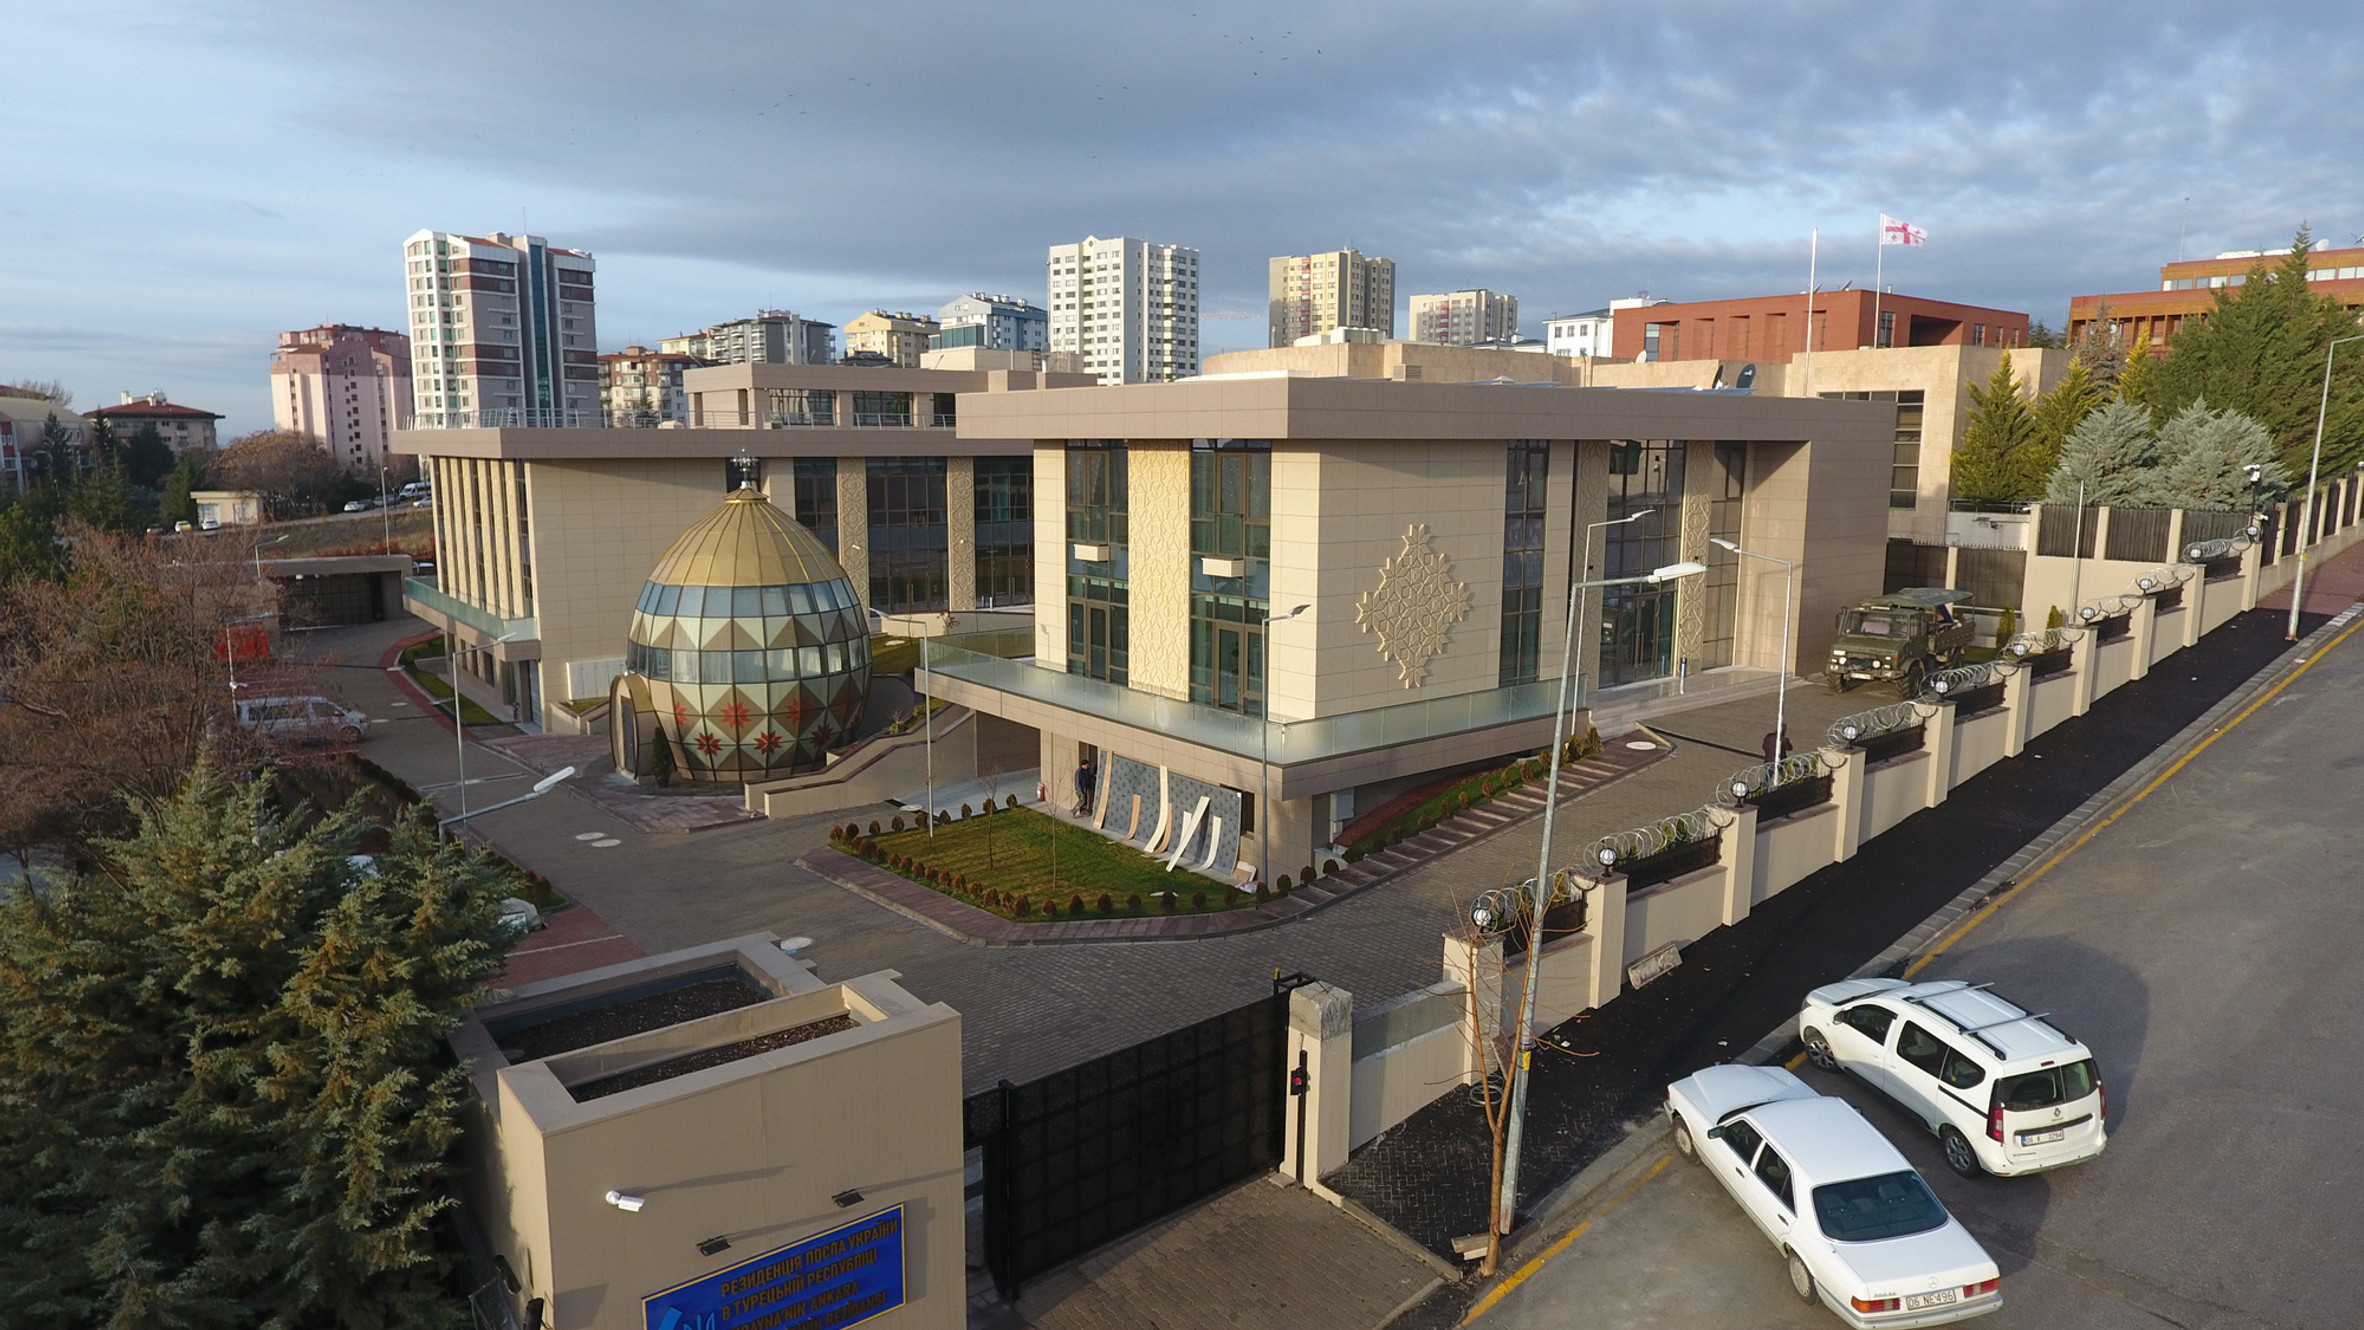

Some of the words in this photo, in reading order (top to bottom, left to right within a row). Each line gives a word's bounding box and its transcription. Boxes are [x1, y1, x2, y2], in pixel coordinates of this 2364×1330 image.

[721, 1254, 802, 1298] РЕЗИДЕНЦІЯ
[805, 1239, 846, 1266] ПОСЛА
[847, 1218, 898, 1250] УКРАЇНИ
[721, 1304, 731, 1321] В
[733, 1272, 805, 1316] ТУРЕЦЬКІЙ
[806, 1247, 878, 1287] РЕСПУБЛІЦІ
[810, 1280, 859, 1311] ANKARA
[1908, 1297, 1920, 1308] 06
